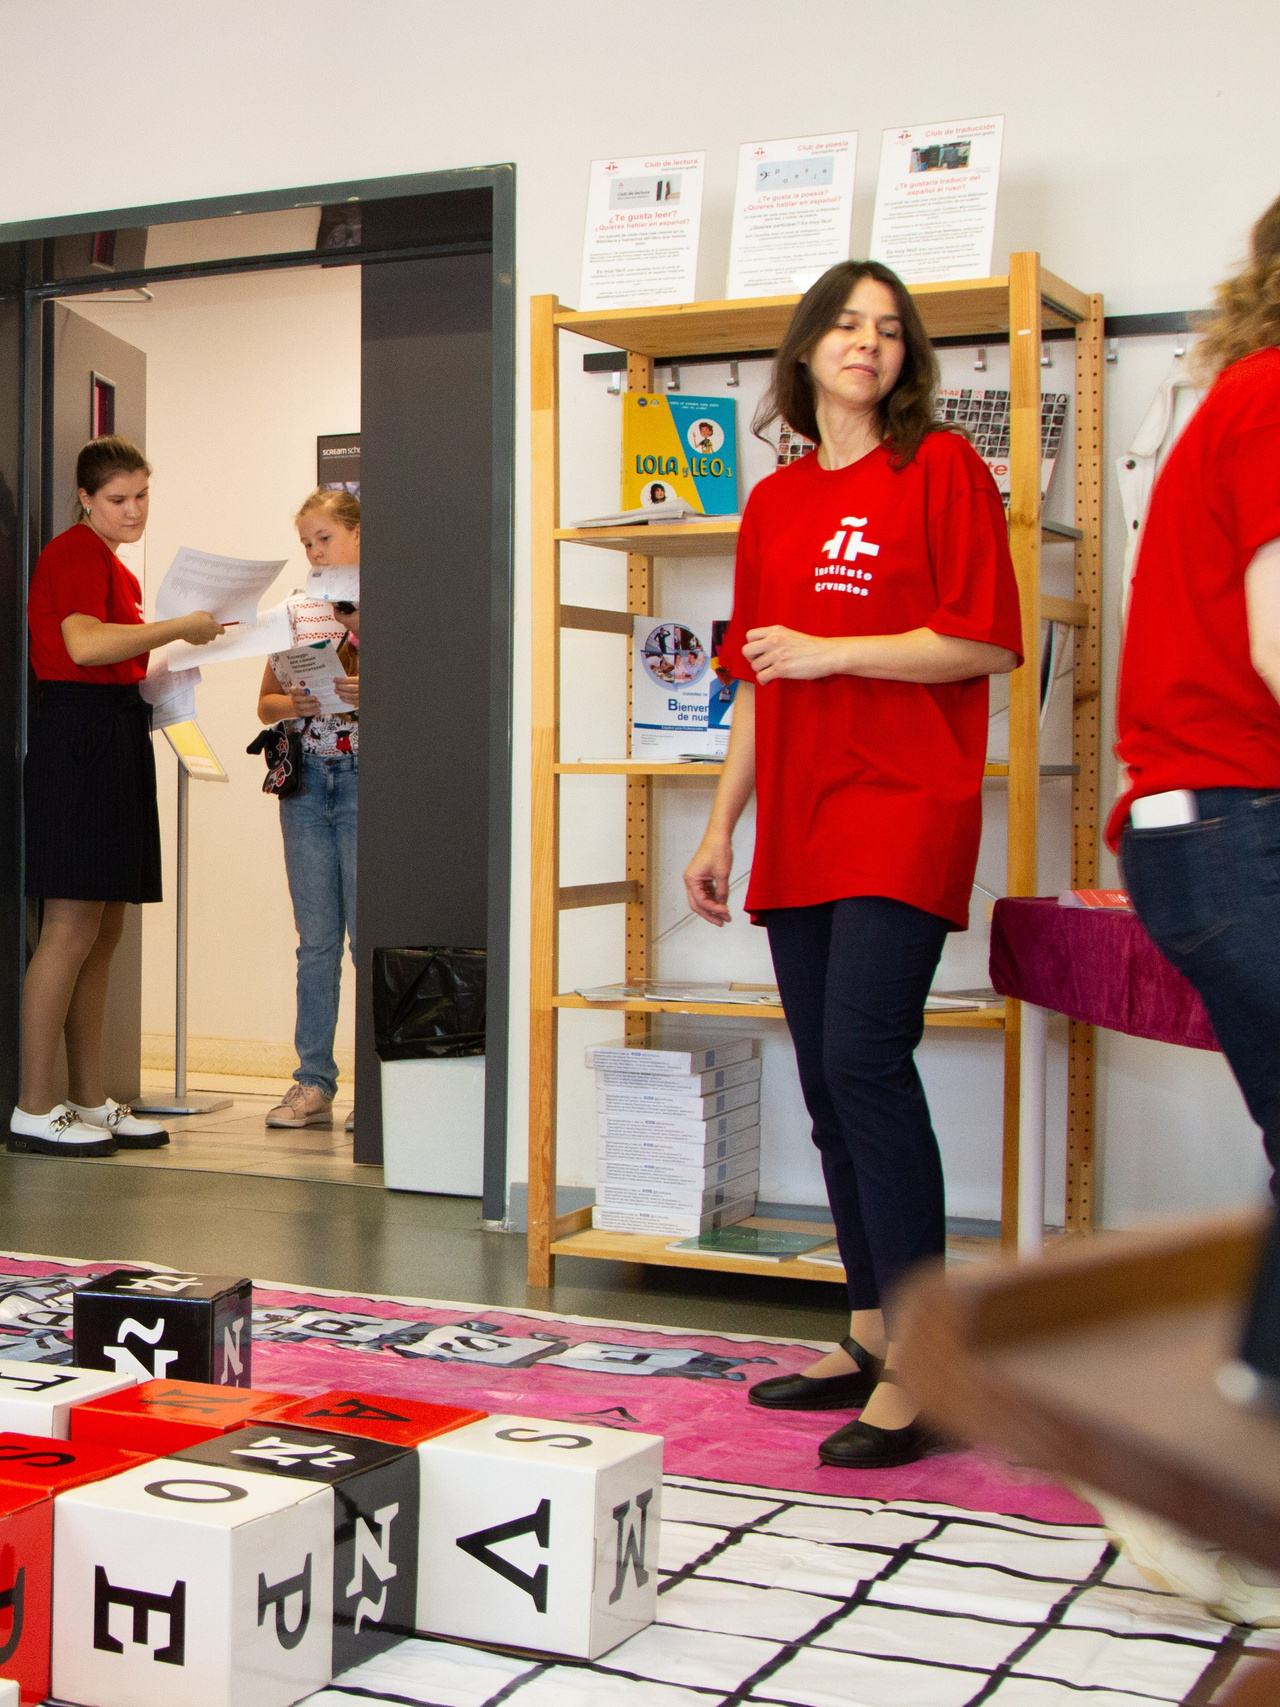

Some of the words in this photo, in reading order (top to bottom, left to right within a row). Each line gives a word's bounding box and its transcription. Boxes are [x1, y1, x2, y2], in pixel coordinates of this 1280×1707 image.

[956, 124, 995, 133] traducción
[628, 212, 652, 222] gusta
[655, 210, 677, 219] leer?
[636, 454, 678, 476] LOLA
[683, 467, 689, 478] y
[691, 457, 724, 477] LEO
[726, 467, 732, 478] 1
[495, 1428, 593, 1450] S
[144, 1479, 249, 1503] O
[93, 1564, 186, 1667] E
